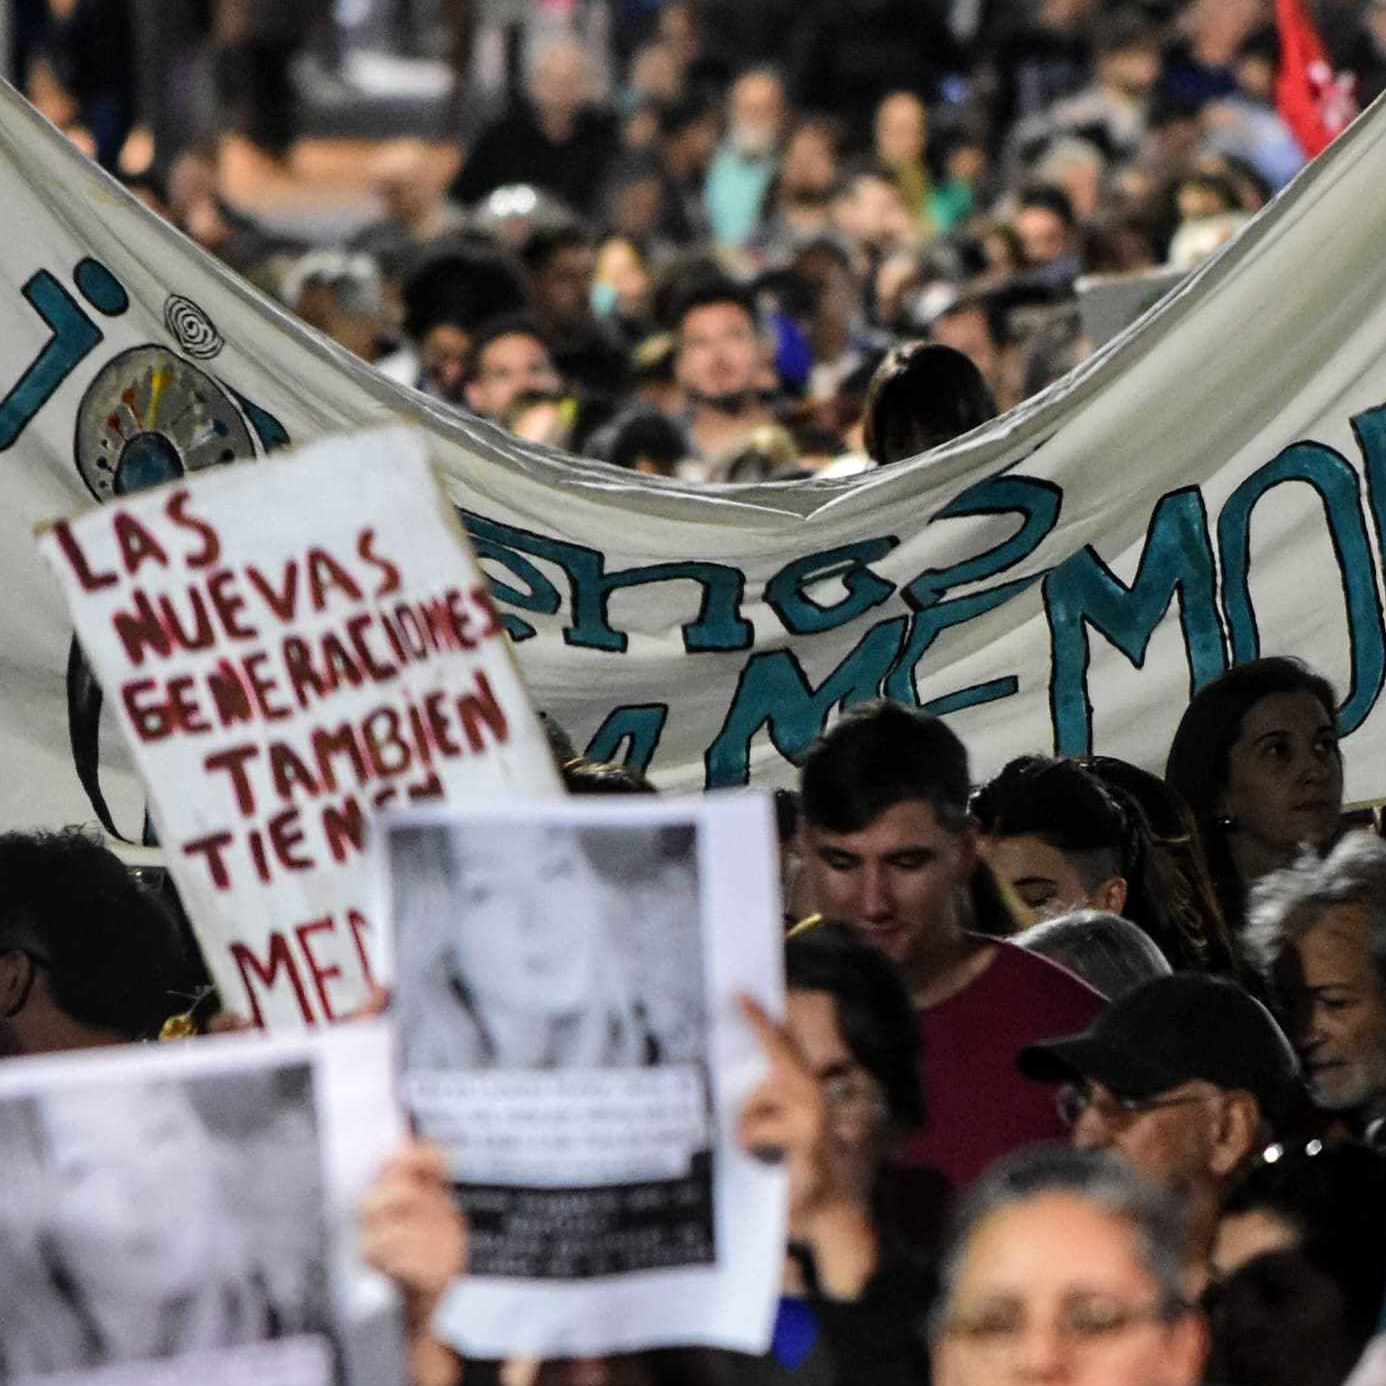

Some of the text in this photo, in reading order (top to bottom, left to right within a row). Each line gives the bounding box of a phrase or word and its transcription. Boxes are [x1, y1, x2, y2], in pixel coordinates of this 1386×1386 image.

[53, 488, 221, 594] LAS
[112, 526, 402, 668] NUEVAS
[120, 586, 506, 742] GENERACIONES
[203, 667, 511, 818] TAMBIEN
